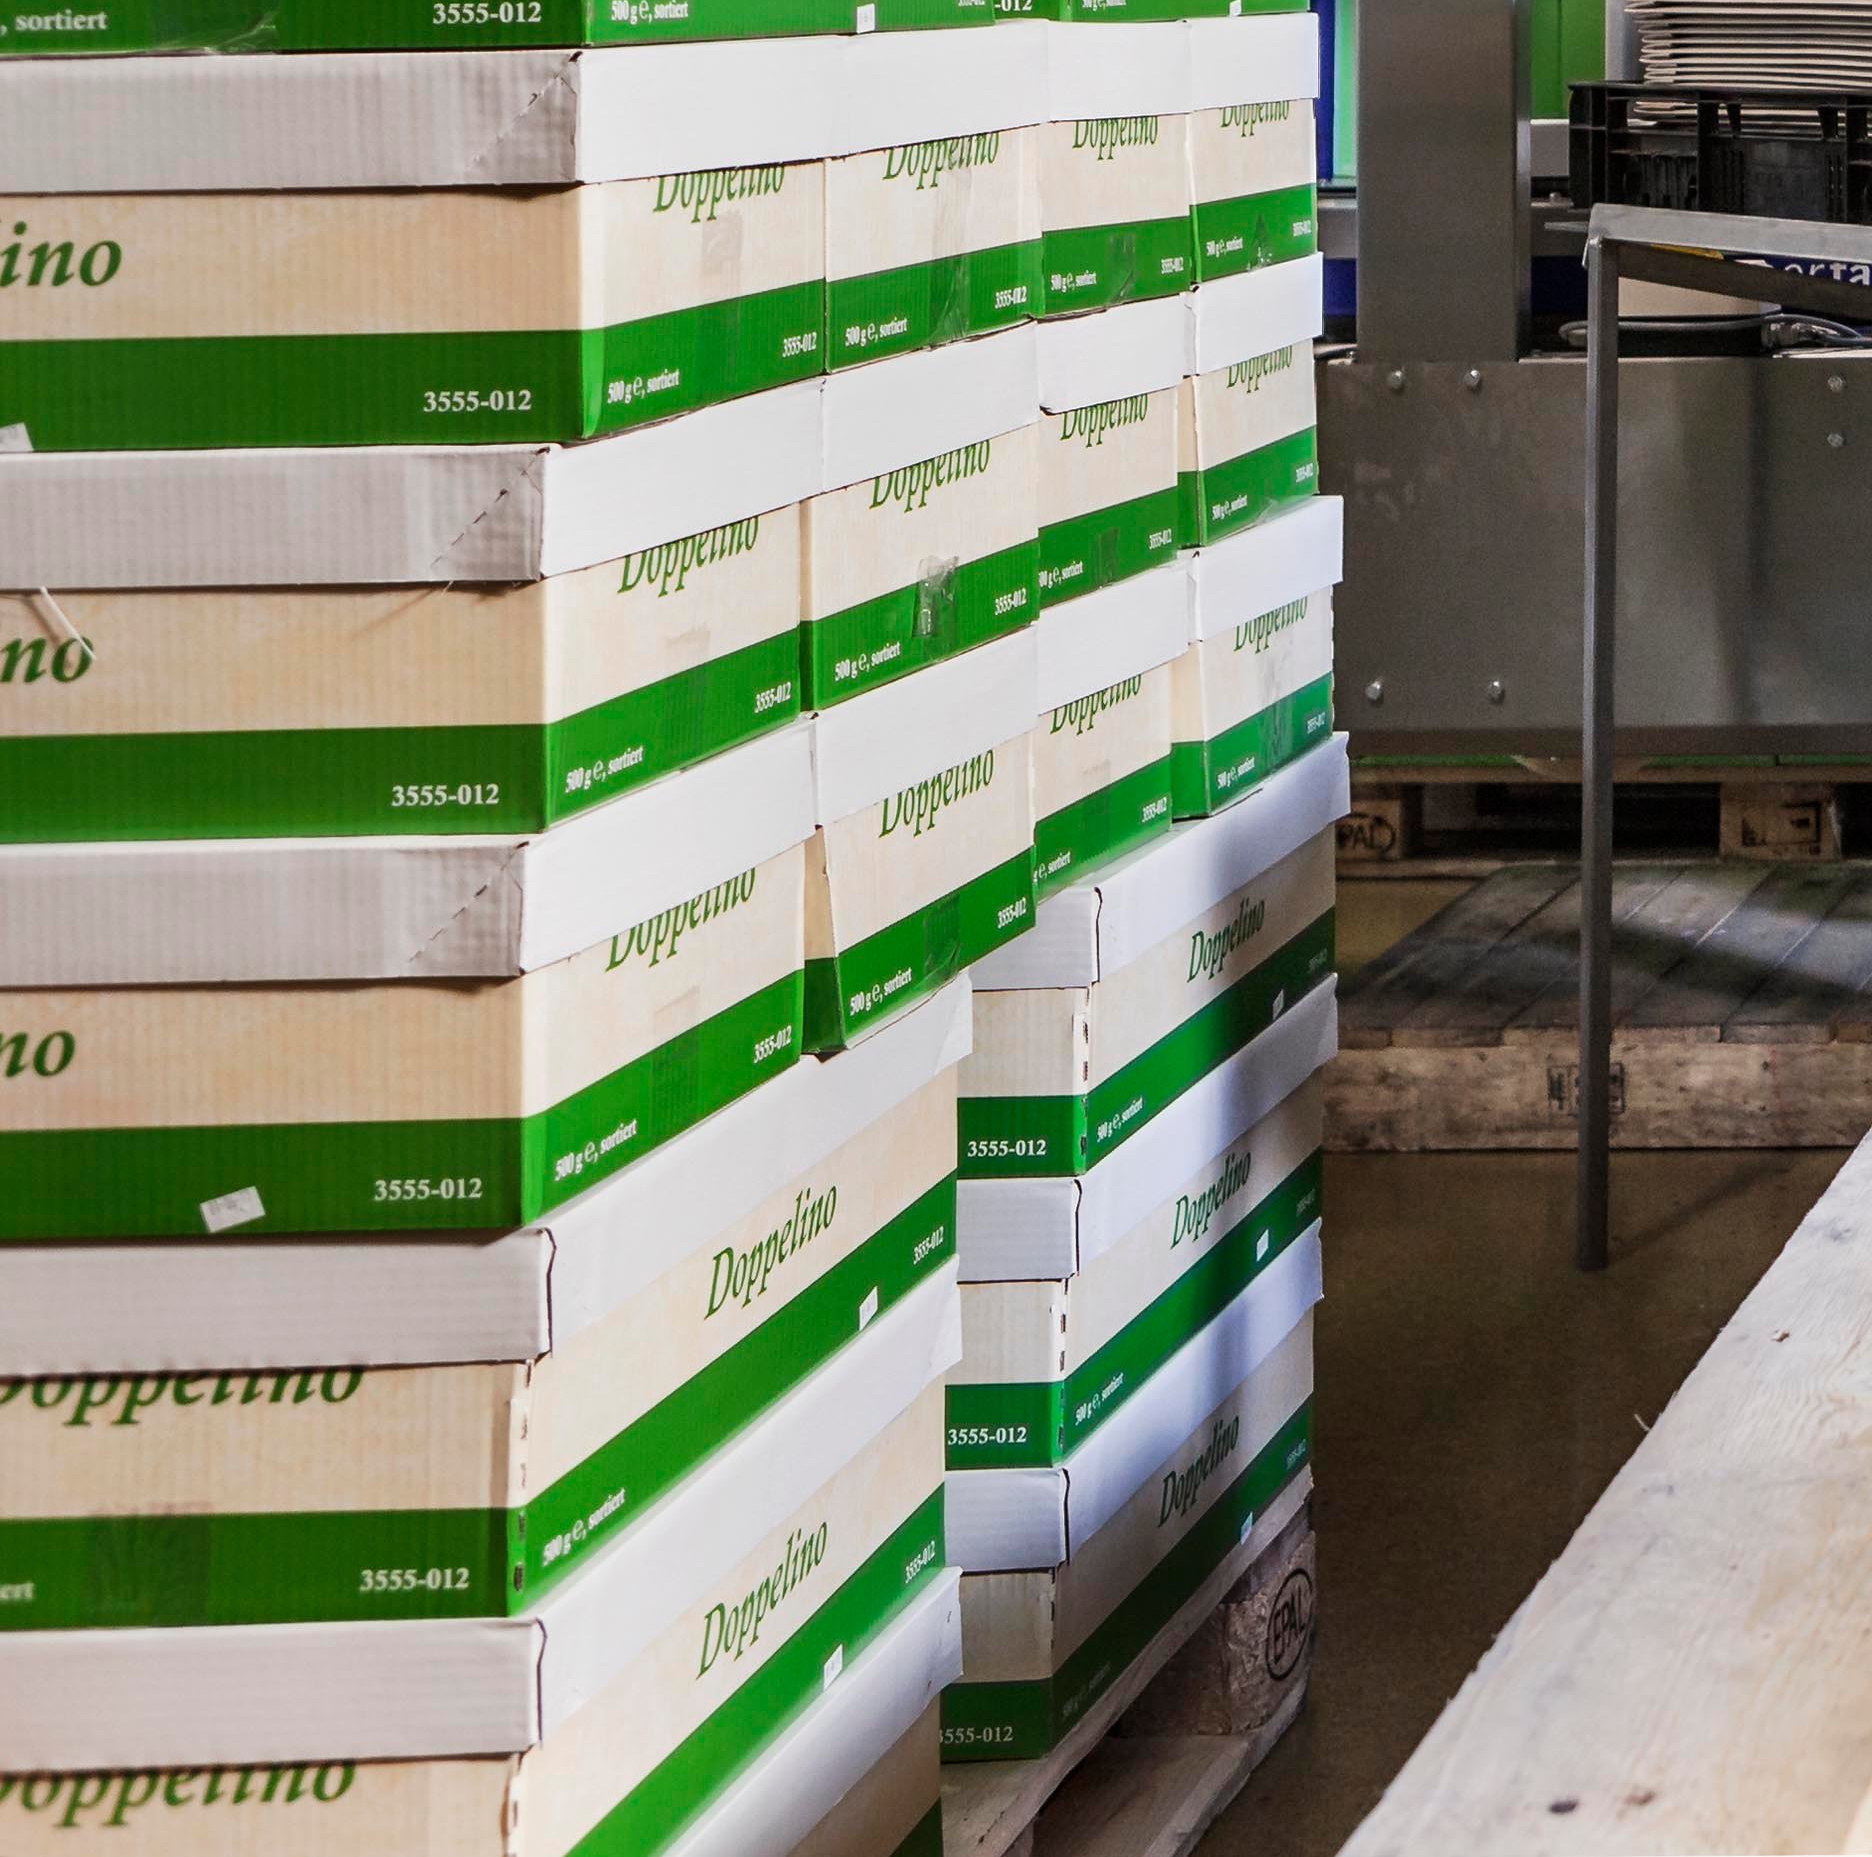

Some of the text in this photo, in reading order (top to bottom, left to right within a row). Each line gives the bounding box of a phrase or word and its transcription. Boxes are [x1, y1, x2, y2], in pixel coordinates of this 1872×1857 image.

[15, 9, 108, 33] sortiert
[432, 1, 542, 25] 3555-012
[611, 0, 630, 21] 500
[994, 286, 1027, 309] 3555-012
[782, 331, 817, 358] 3555-012
[845, 323, 860, 346] 500
[879, 316, 908, 338] sortiert
[423, 389, 532, 413] 3555-012
[607, 378, 624, 403] 500
[646, 368, 680, 393] sortiert
[994, 588, 1027, 616] 3555-012
[835, 659, 851, 682] 500
[871, 641, 900, 667] sortiert
[754, 681, 792, 714] 3555-012
[565, 770, 584, 793] 500
[607, 745, 643, 775] sortiert
[391, 783, 500, 807] 3555-012
[1186, 897, 1265, 983] Doppelino
[850, 991, 866, 1017] 500
[884, 967, 912, 995] sortiert
[554, 1151, 574, 1182] 500
[599, 1119, 637, 1155] sortiert
[967, 1139, 1046, 1158] 3555-012
[374, 1178, 483, 1201] 3555-012
[1170, 1153, 1251, 1248] Doppelino
[703, 1185, 838, 1320] Doppelino
[912, 1226, 944, 1267] 3555-012
[0, 1367, 364, 1425] oppelino
[948, 1426, 1027, 1445] 3555-012
[1158, 1415, 1239, 1528] Doppelino
[904, 1540, 937, 1584] 3555-012
[360, 1568, 470, 1592] 3555-012
[696, 1521, 828, 1680] Doppelino
[0, 1761, 355, 1828] oppelino
